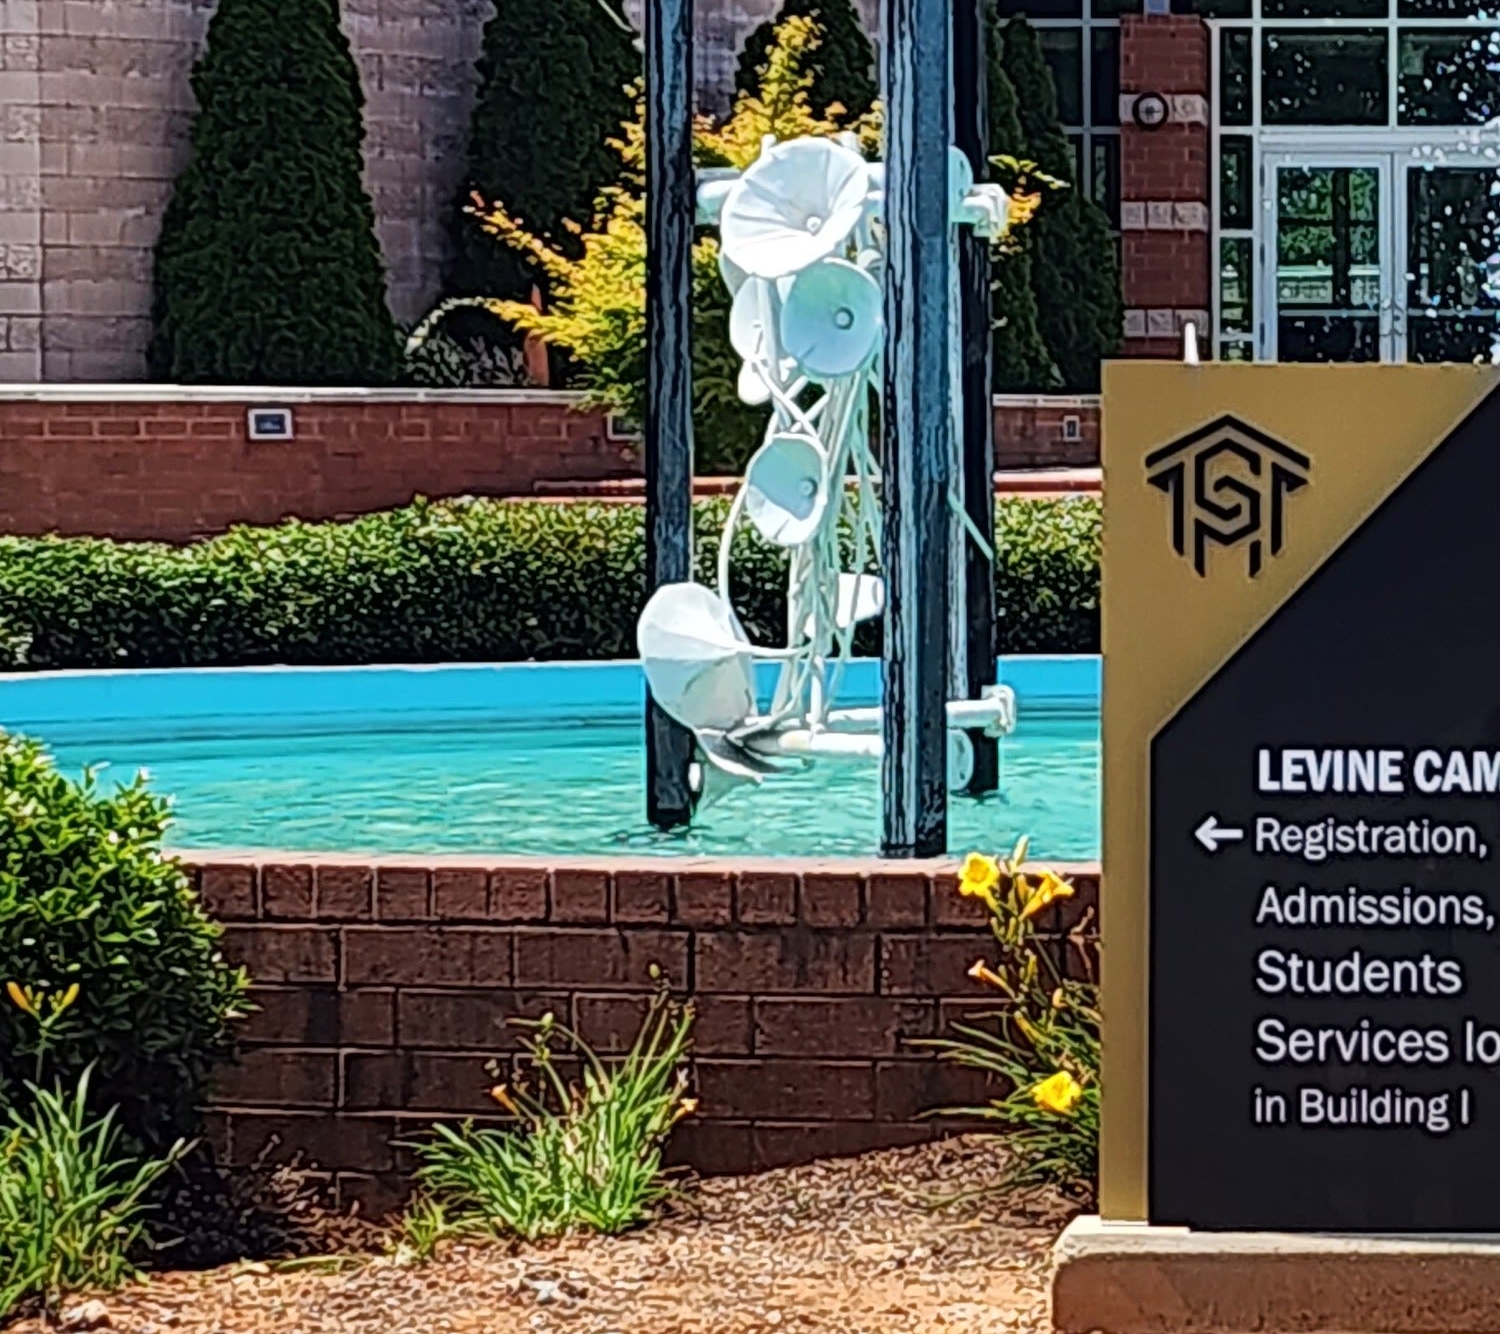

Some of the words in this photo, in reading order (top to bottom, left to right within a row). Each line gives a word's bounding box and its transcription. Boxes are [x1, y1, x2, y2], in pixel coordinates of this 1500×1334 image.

[1258, 749, 1404, 793] LEVINE
[1256, 817, 1488, 860] Registration,
[1256, 886, 1494, 930] Admissions,
[1256, 949, 1463, 994] Students
[1256, 1019, 1449, 1063] Services
[1255, 1088, 1286, 1123] in
[1300, 1088, 1450, 1132] Building
